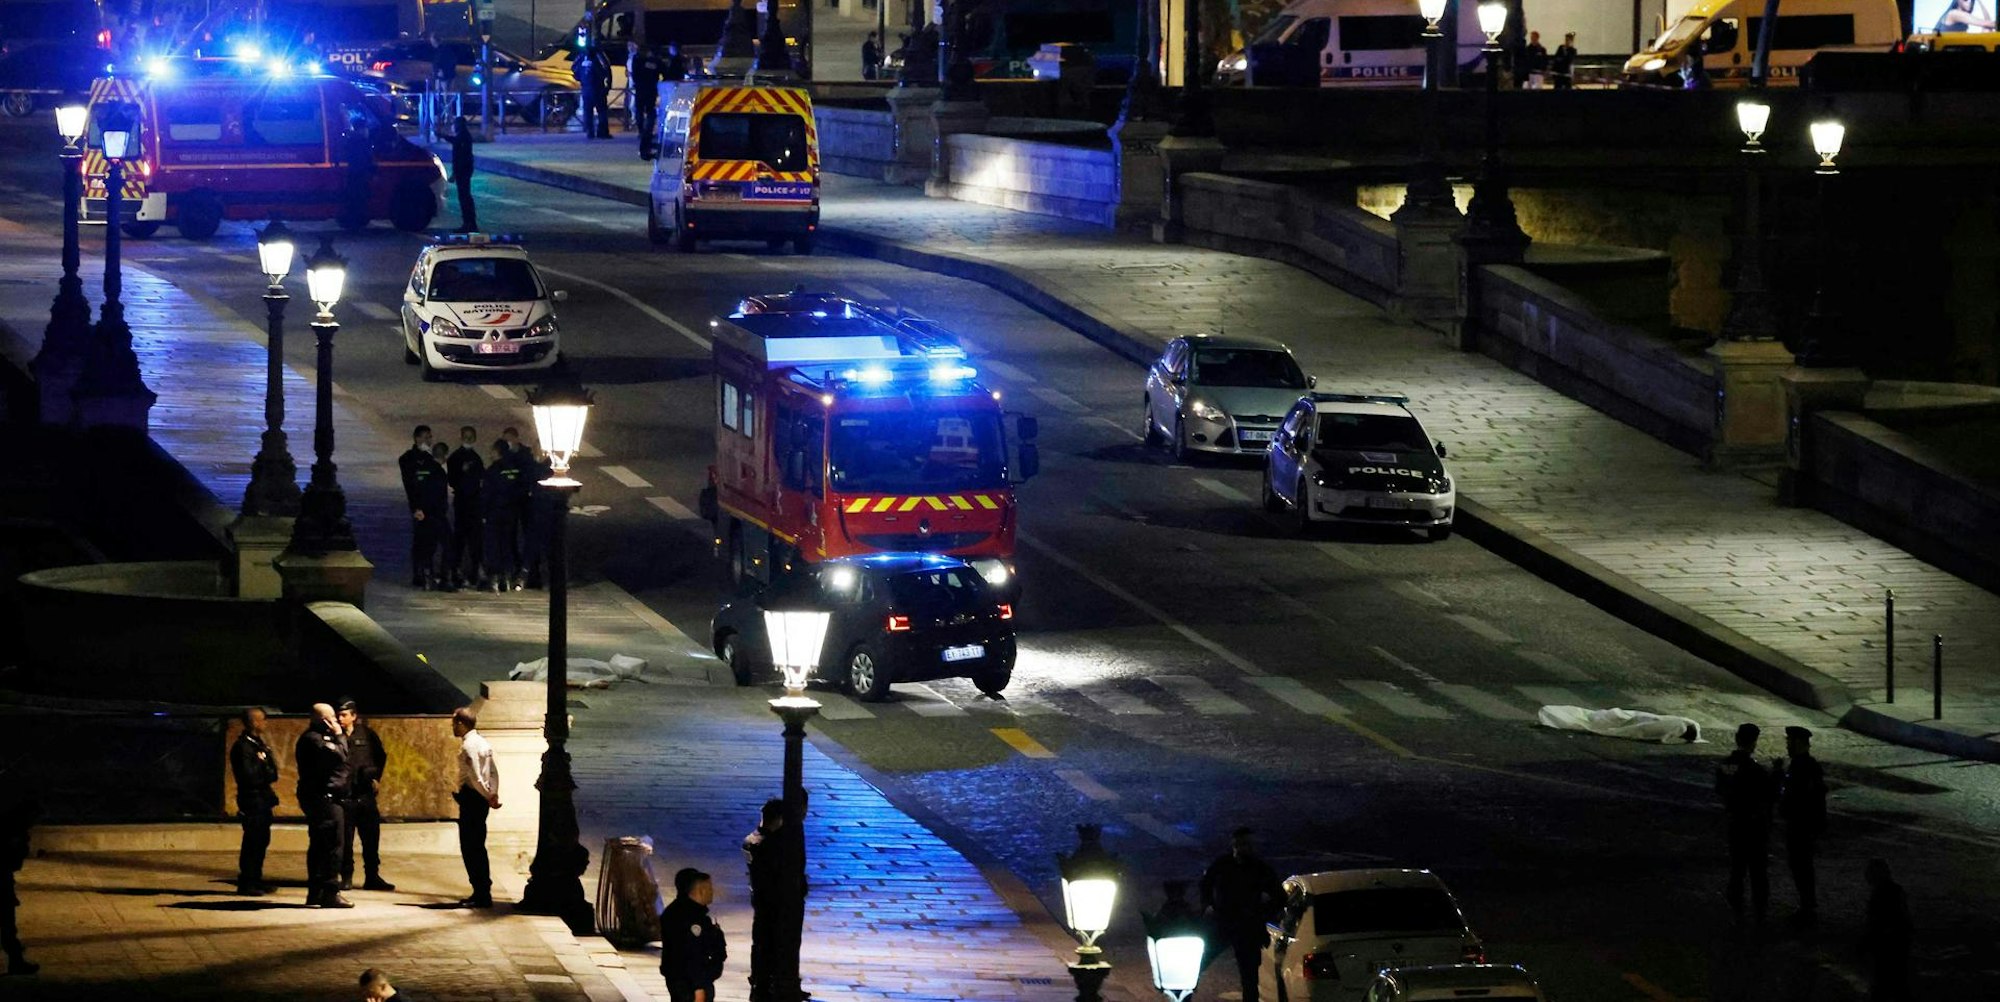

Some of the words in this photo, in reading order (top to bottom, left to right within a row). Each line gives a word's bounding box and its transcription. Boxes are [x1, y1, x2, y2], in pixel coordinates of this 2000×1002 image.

[1352, 67, 1407, 77] POLICE
[755, 186, 787, 194] POLICE
[1349, 467, 1424, 478] POLICE
